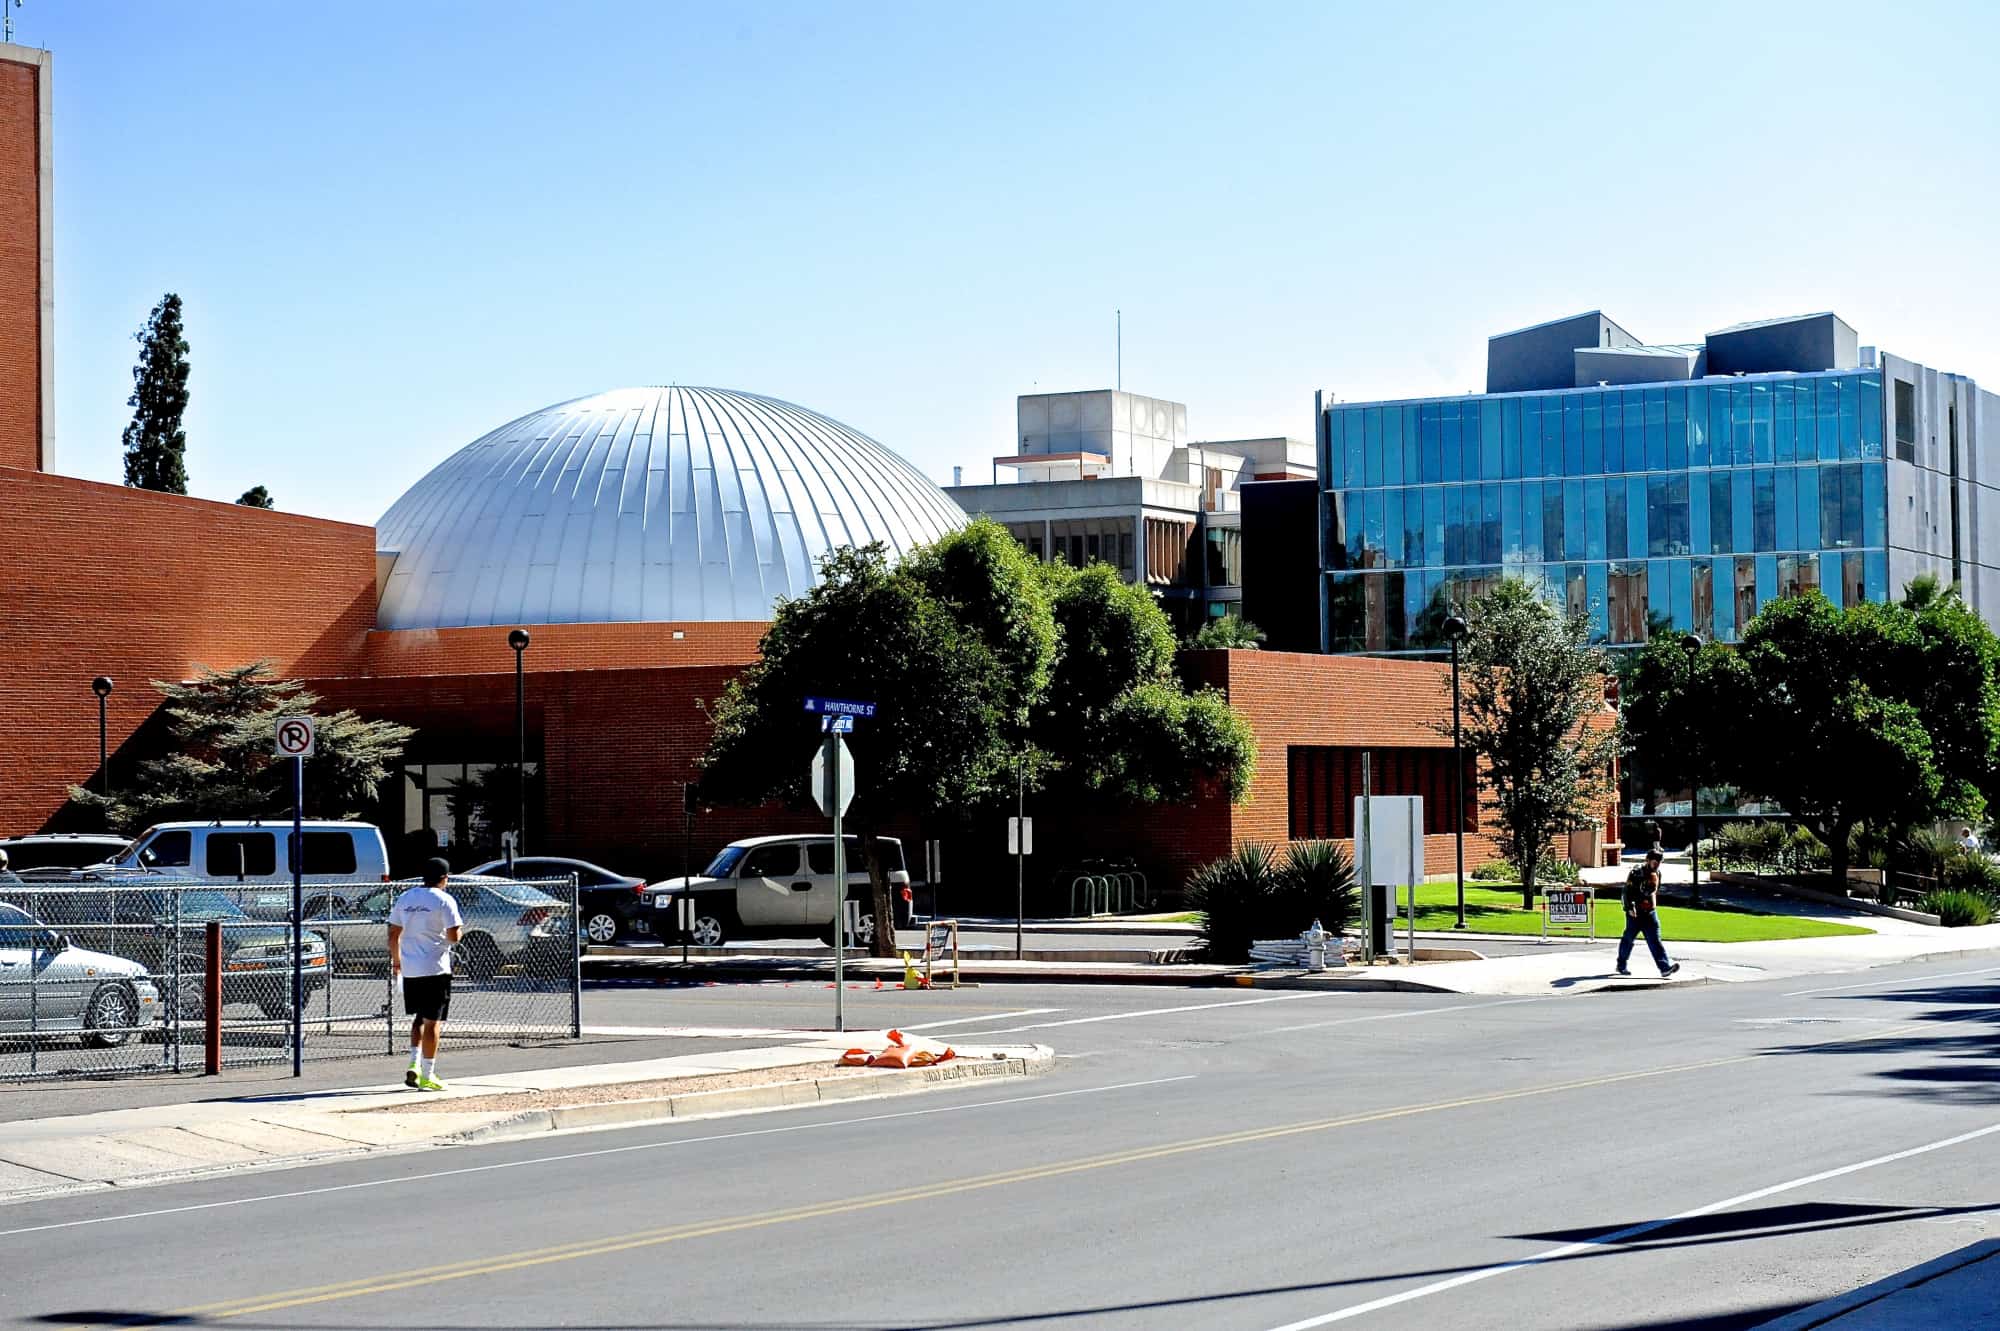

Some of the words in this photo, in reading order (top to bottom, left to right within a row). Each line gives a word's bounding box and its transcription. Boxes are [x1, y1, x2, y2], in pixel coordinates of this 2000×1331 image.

[824, 701, 865, 714] HAWTHORNE
[866, 705, 875, 716] ST
[1559, 893, 1575, 903] LOT
[1550, 904, 1587, 914] RESERVED
[1007, 1060, 1022, 1074] AVE
